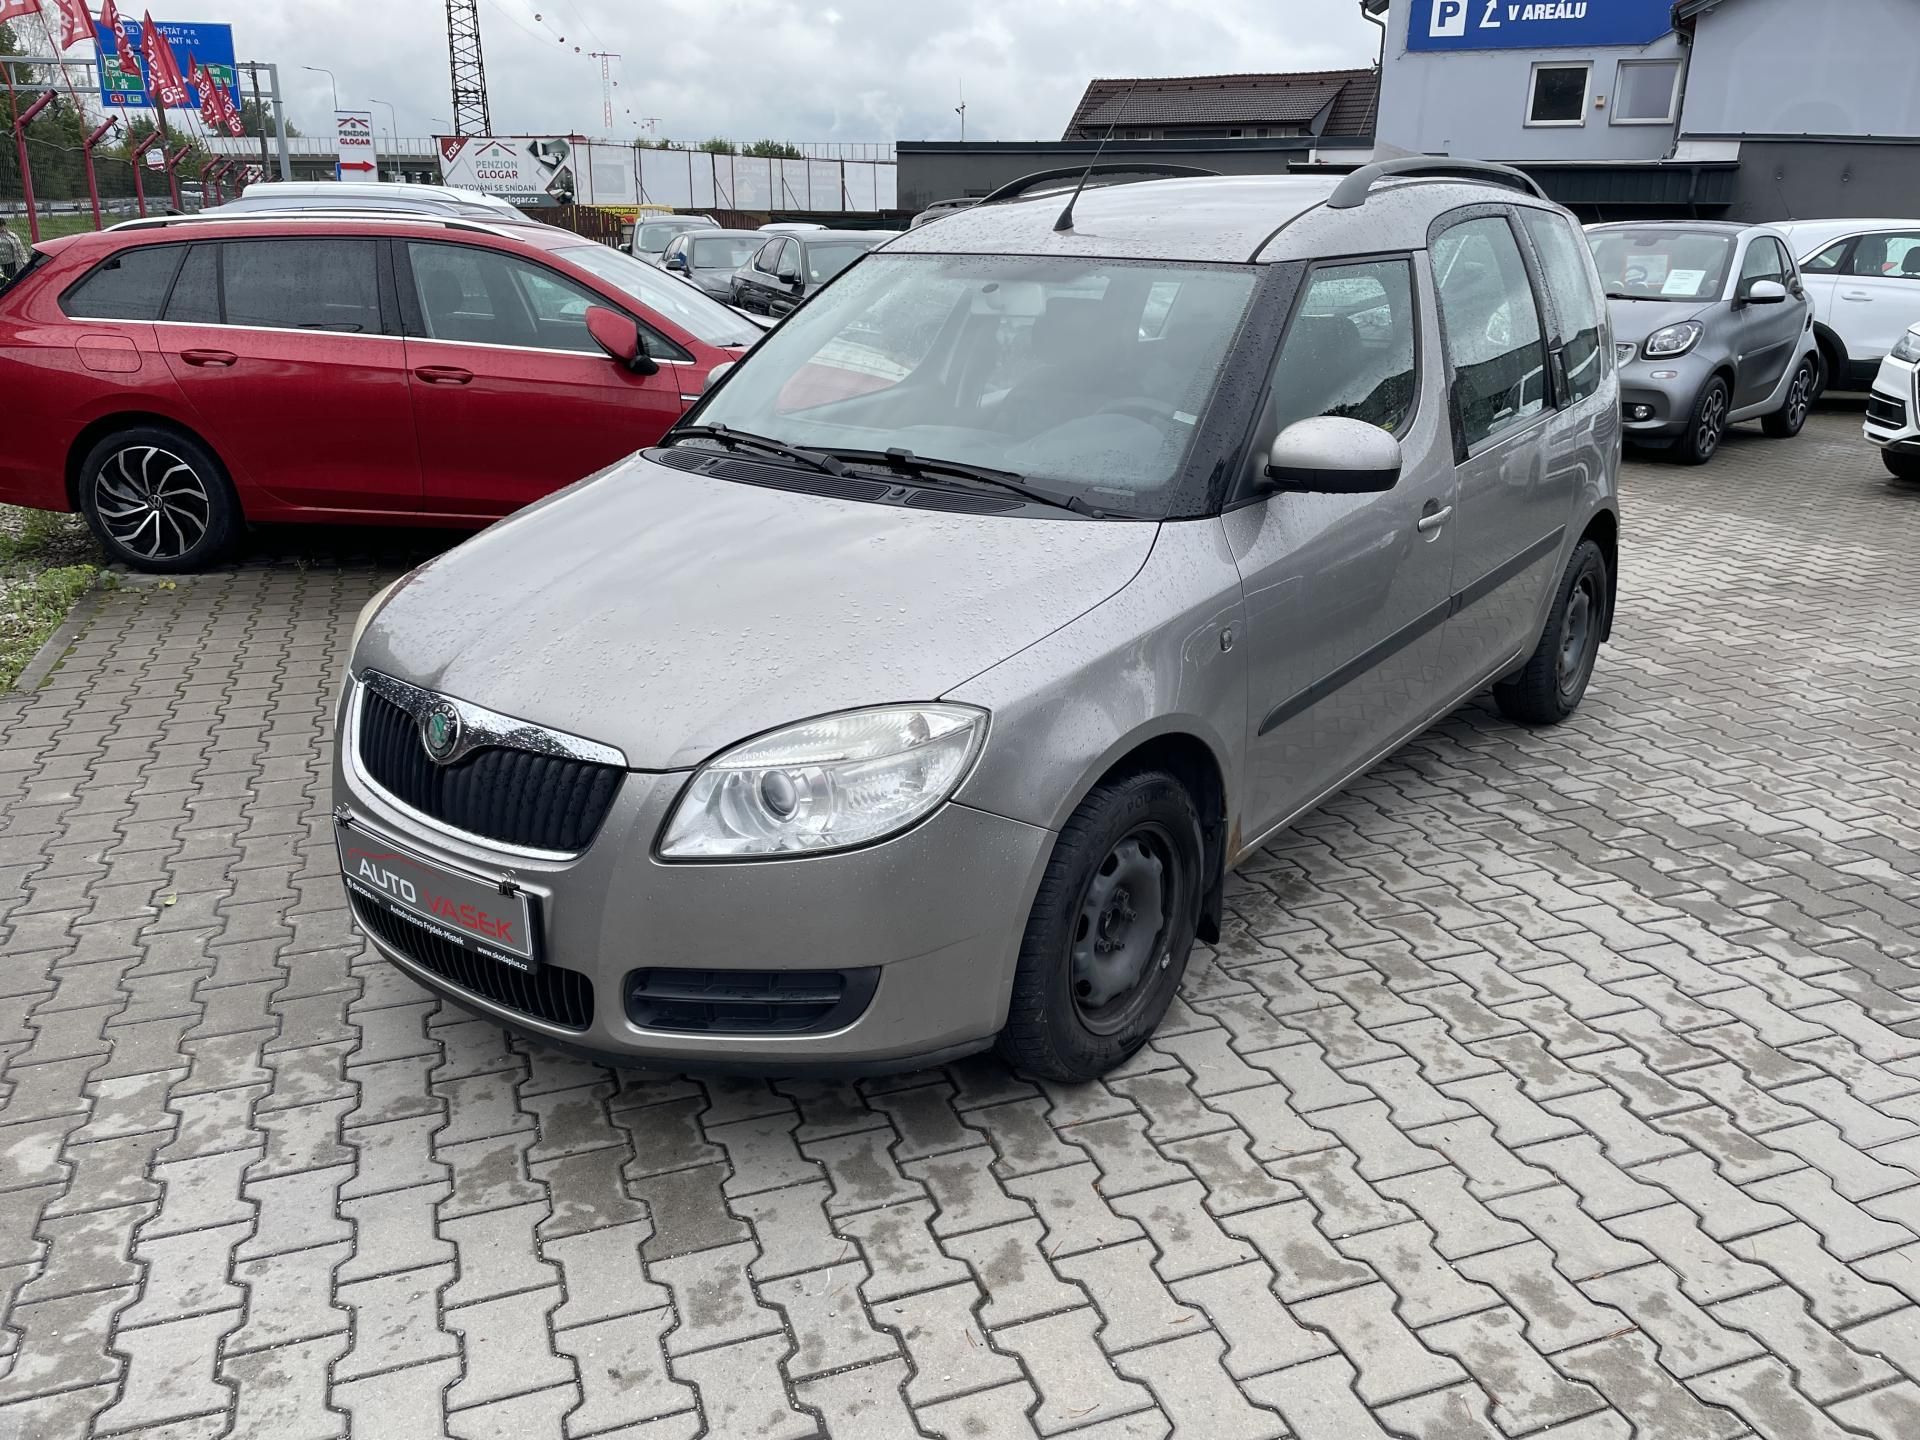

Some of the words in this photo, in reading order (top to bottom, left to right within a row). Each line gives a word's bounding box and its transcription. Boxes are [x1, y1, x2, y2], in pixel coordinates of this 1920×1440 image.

[1508, 5, 1520, 21] V
[1522, 0, 1588, 20] AREÁLU
[445, 141, 461, 159] ZDE
[475, 160, 518, 169] PENZION
[477, 170, 519, 179] GLOGAR
[494, 184, 503, 192] SE
[504, 182, 537, 192] SNÍDANÍ
[359, 857, 417, 903] AUTO
